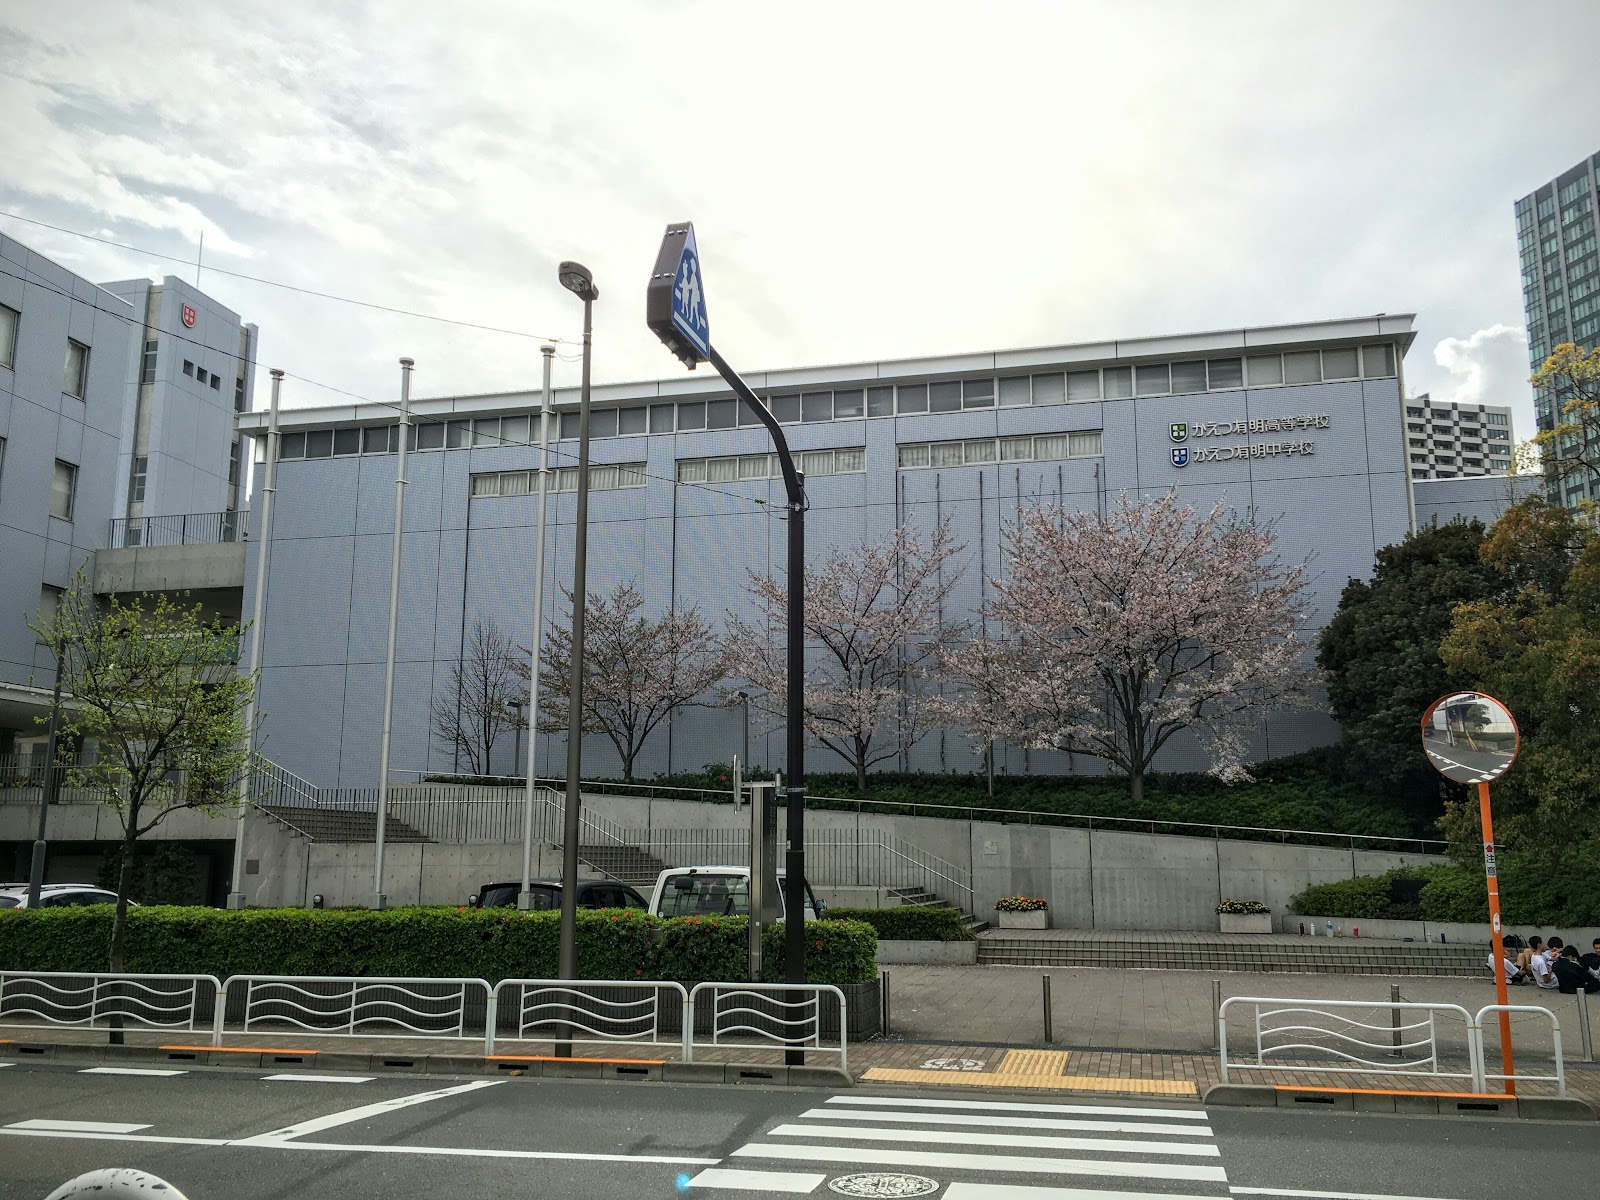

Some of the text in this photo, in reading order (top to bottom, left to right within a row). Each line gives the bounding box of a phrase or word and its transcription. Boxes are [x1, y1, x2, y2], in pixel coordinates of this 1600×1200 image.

[1193, 413, 1329, 437] かえつ有明高等学校
[1193, 440, 1314, 462] かえつ有明中学校
